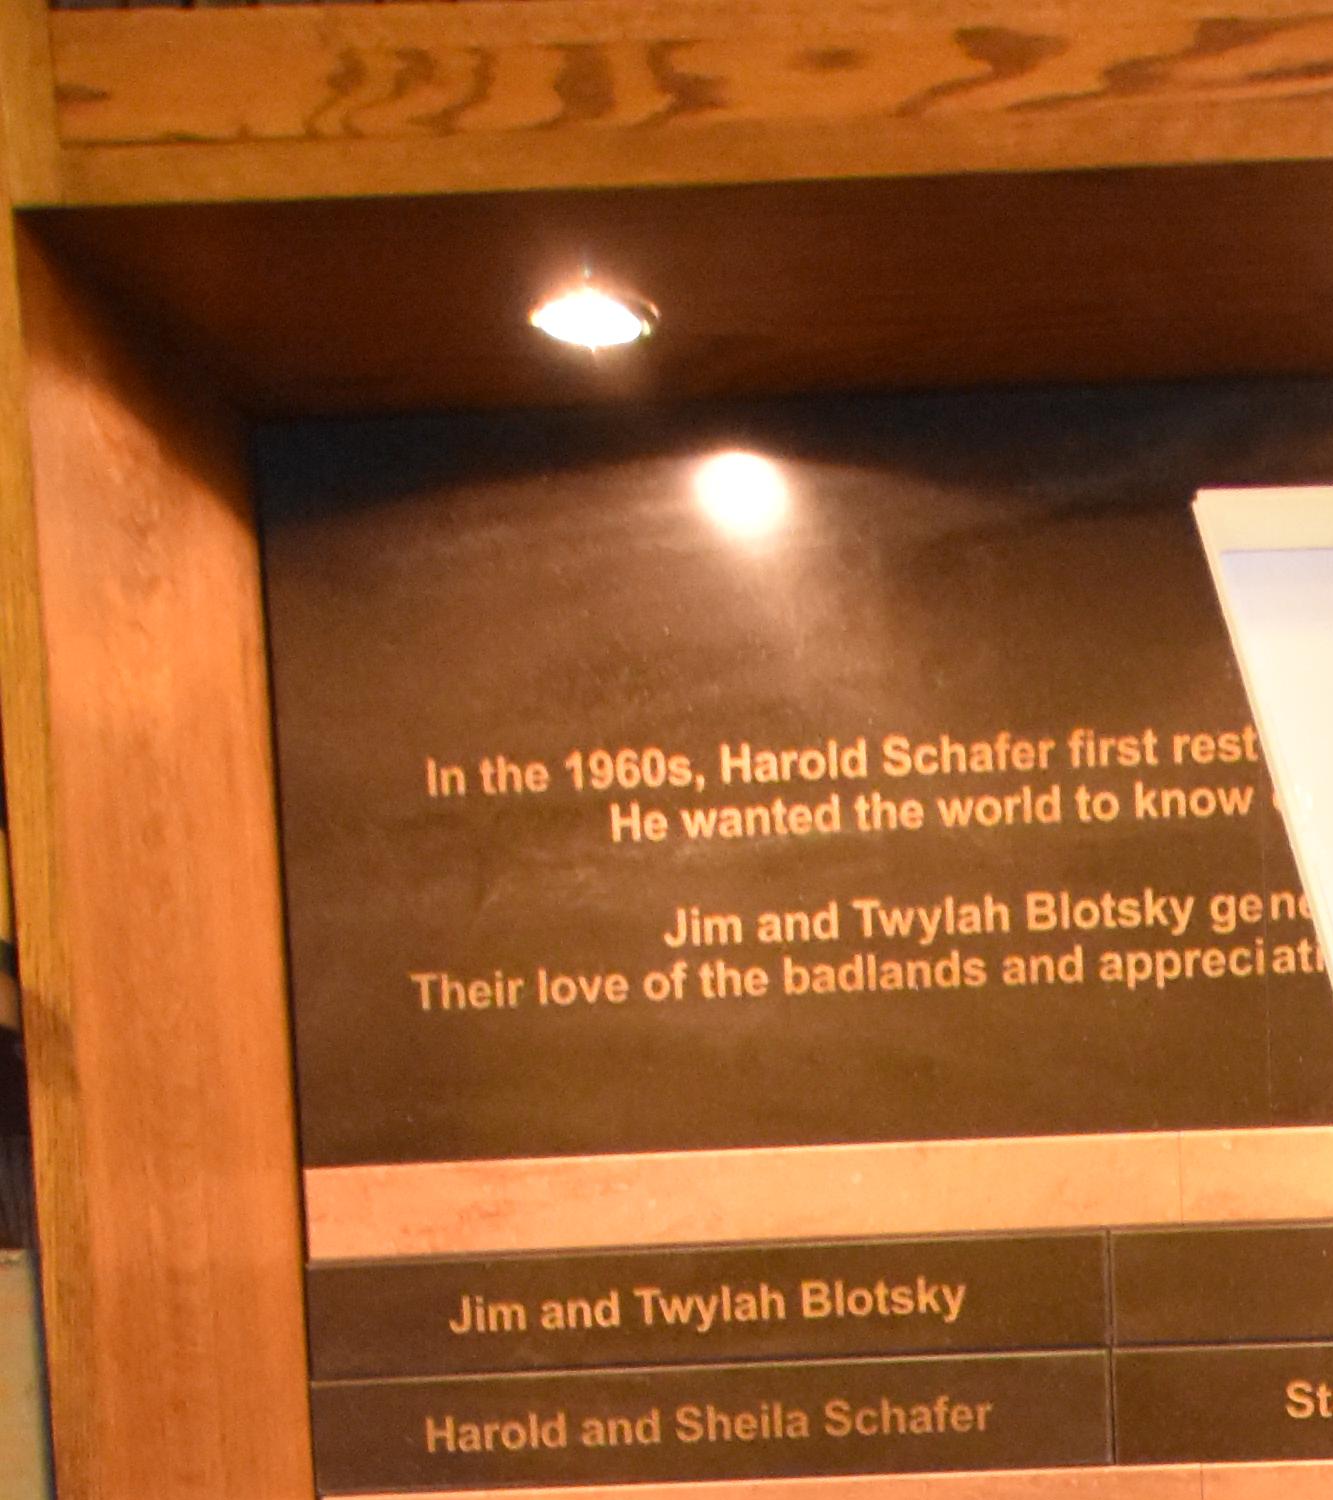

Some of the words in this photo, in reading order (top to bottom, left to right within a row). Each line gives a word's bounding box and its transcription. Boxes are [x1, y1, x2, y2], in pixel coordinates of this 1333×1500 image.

[426, 758, 466, 797] In
[479, 755, 550, 795] the
[565, 747, 705, 792] 1960s,
[720, 737, 868, 785] Harold
[882, 732, 1056, 777] Schafer
[1067, 728, 1159, 768] first
[1173, 721, 1259, 766] rest
[610, 802, 669, 843] He
[680, 792, 841, 840] wanted
[853, 791, 925, 832] the
[936, 784, 1062, 828] world
[1074, 784, 1120, 823] to
[1134, 780, 1254, 819] know
[663, 906, 743, 948] Jim
[757, 900, 839, 943] and
[851, 894, 1010, 943] Twylah
[1026, 887, 1195, 936] Blotsky
[410, 970, 525, 1011] Their
[537, 968, 629, 1006] love
[643, 959, 688, 1001] of
[698, 958, 770, 1000] the
[783, 949, 987, 995] badlands
[1002, 943, 1084, 986] and
[449, 1295, 527, 1334] Jim
[540, 1290, 621, 1330] and
[633, 1282, 786, 1332] Twylah
[800, 1276, 966, 1324] Blotsky
[425, 1411, 568, 1453] Harold
[581, 1407, 661, 1447] and
[675, 1401, 810, 1444] Sheila
[824, 1394, 993, 1437] Schafer
